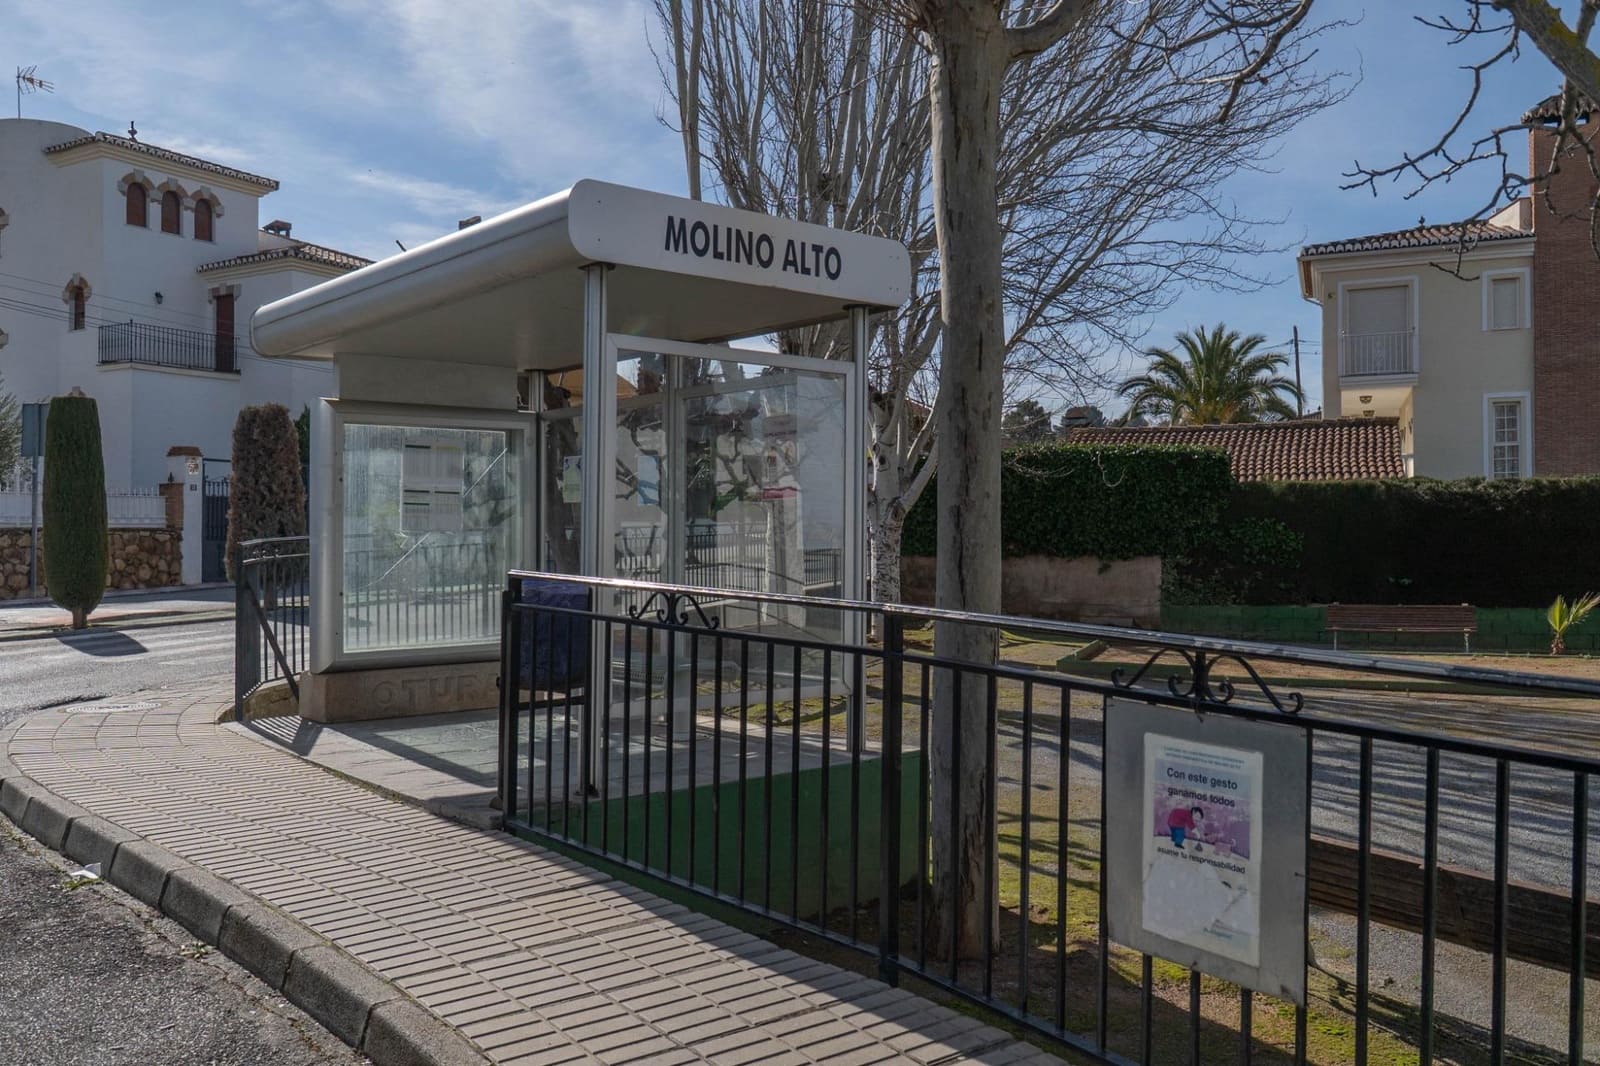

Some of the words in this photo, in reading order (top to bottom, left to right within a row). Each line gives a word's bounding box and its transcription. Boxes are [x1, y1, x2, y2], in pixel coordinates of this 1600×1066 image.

[665, 215, 774, 269] MOLINO
[782, 239, 842, 281] ALTO
[1166, 767, 1185, 781] Con
[1187, 773, 1208, 784] este
[1210, 778, 1238, 790] gesto
[1167, 787, 1208, 801] ganamos
[1209, 794, 1236, 807] todos
[1157, 846, 1179, 857] asume
[1180, 851, 1188, 859] tu
[1188, 853, 1246, 874] responsabilidad
